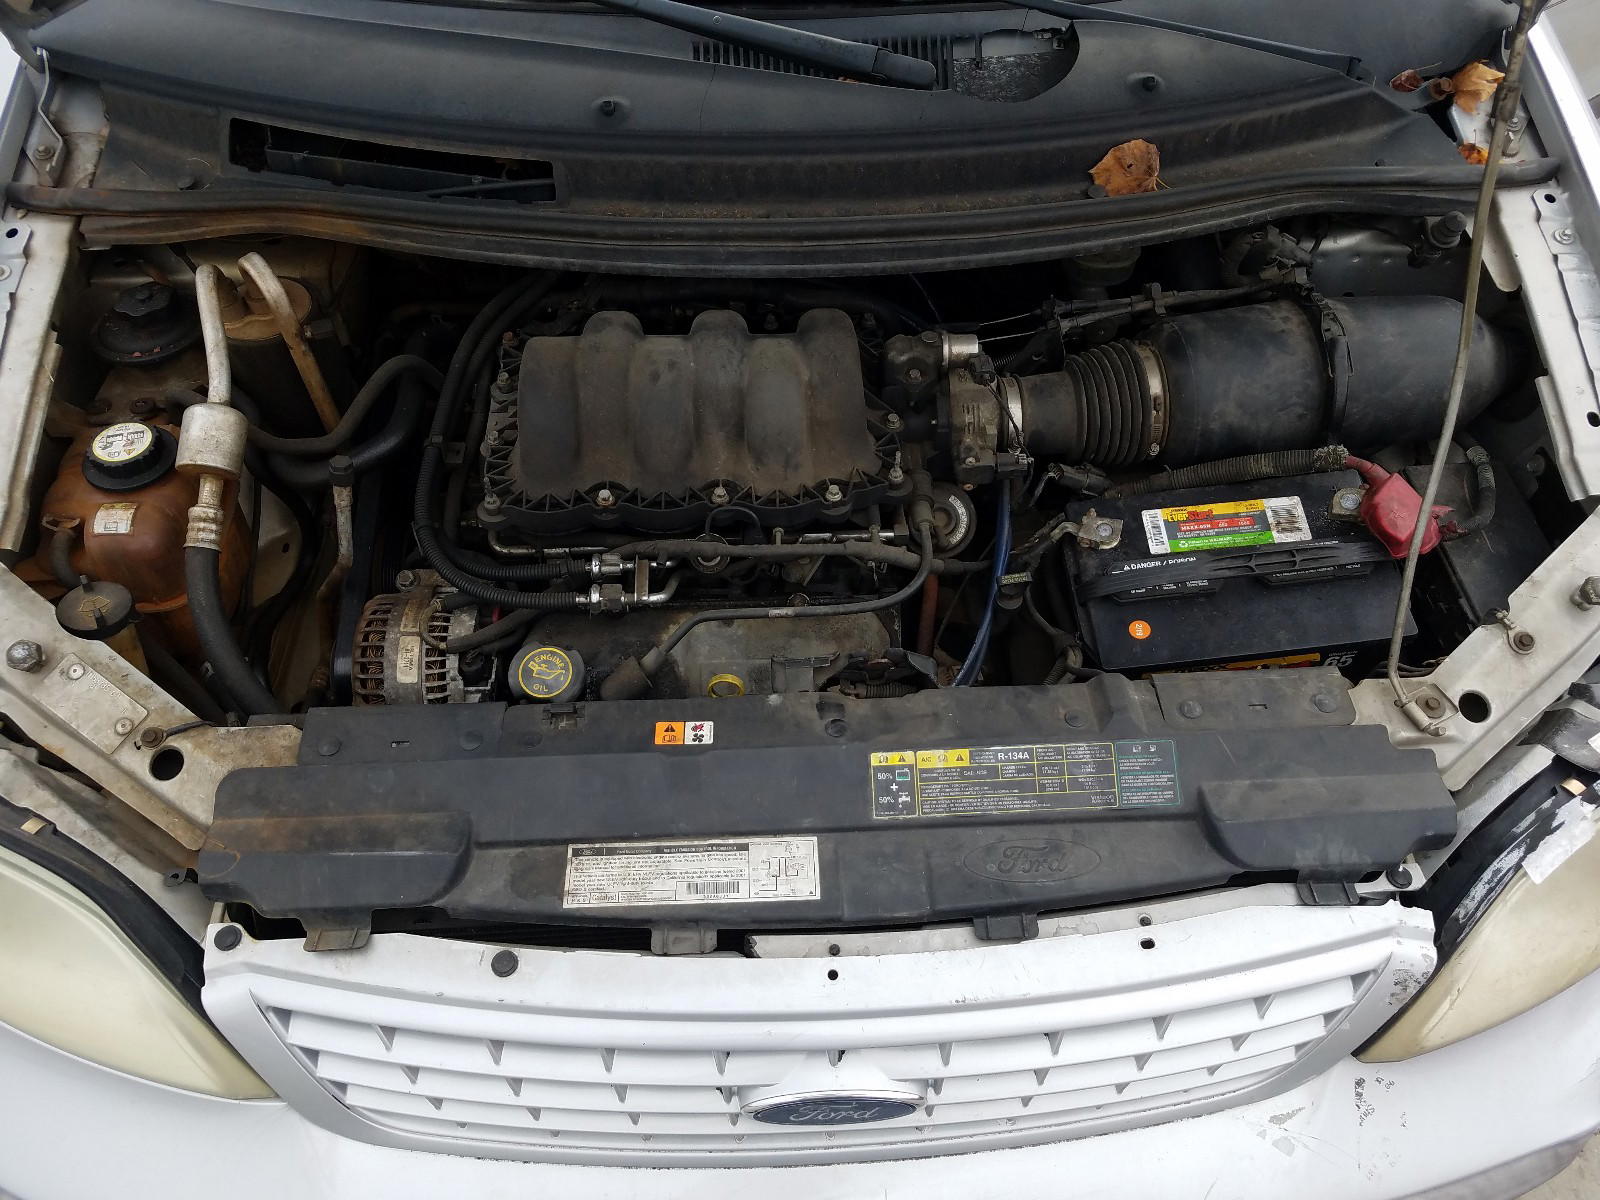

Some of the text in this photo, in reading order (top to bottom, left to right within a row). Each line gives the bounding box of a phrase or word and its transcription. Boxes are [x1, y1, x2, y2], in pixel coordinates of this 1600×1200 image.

[1166, 508, 1215, 522] EverStart
[1130, 560, 1162, 570] DANGER
[534, 653, 566, 668] ENGINE
[1323, 654, 1356, 667] 65
[533, 683, 549, 692] OIL
[997, 751, 1030, 761] R-134A
[878, 795, 895, 804] 50%
[997, 845, 1071, 874] Ford
[789, 1101, 881, 1122] Ford
